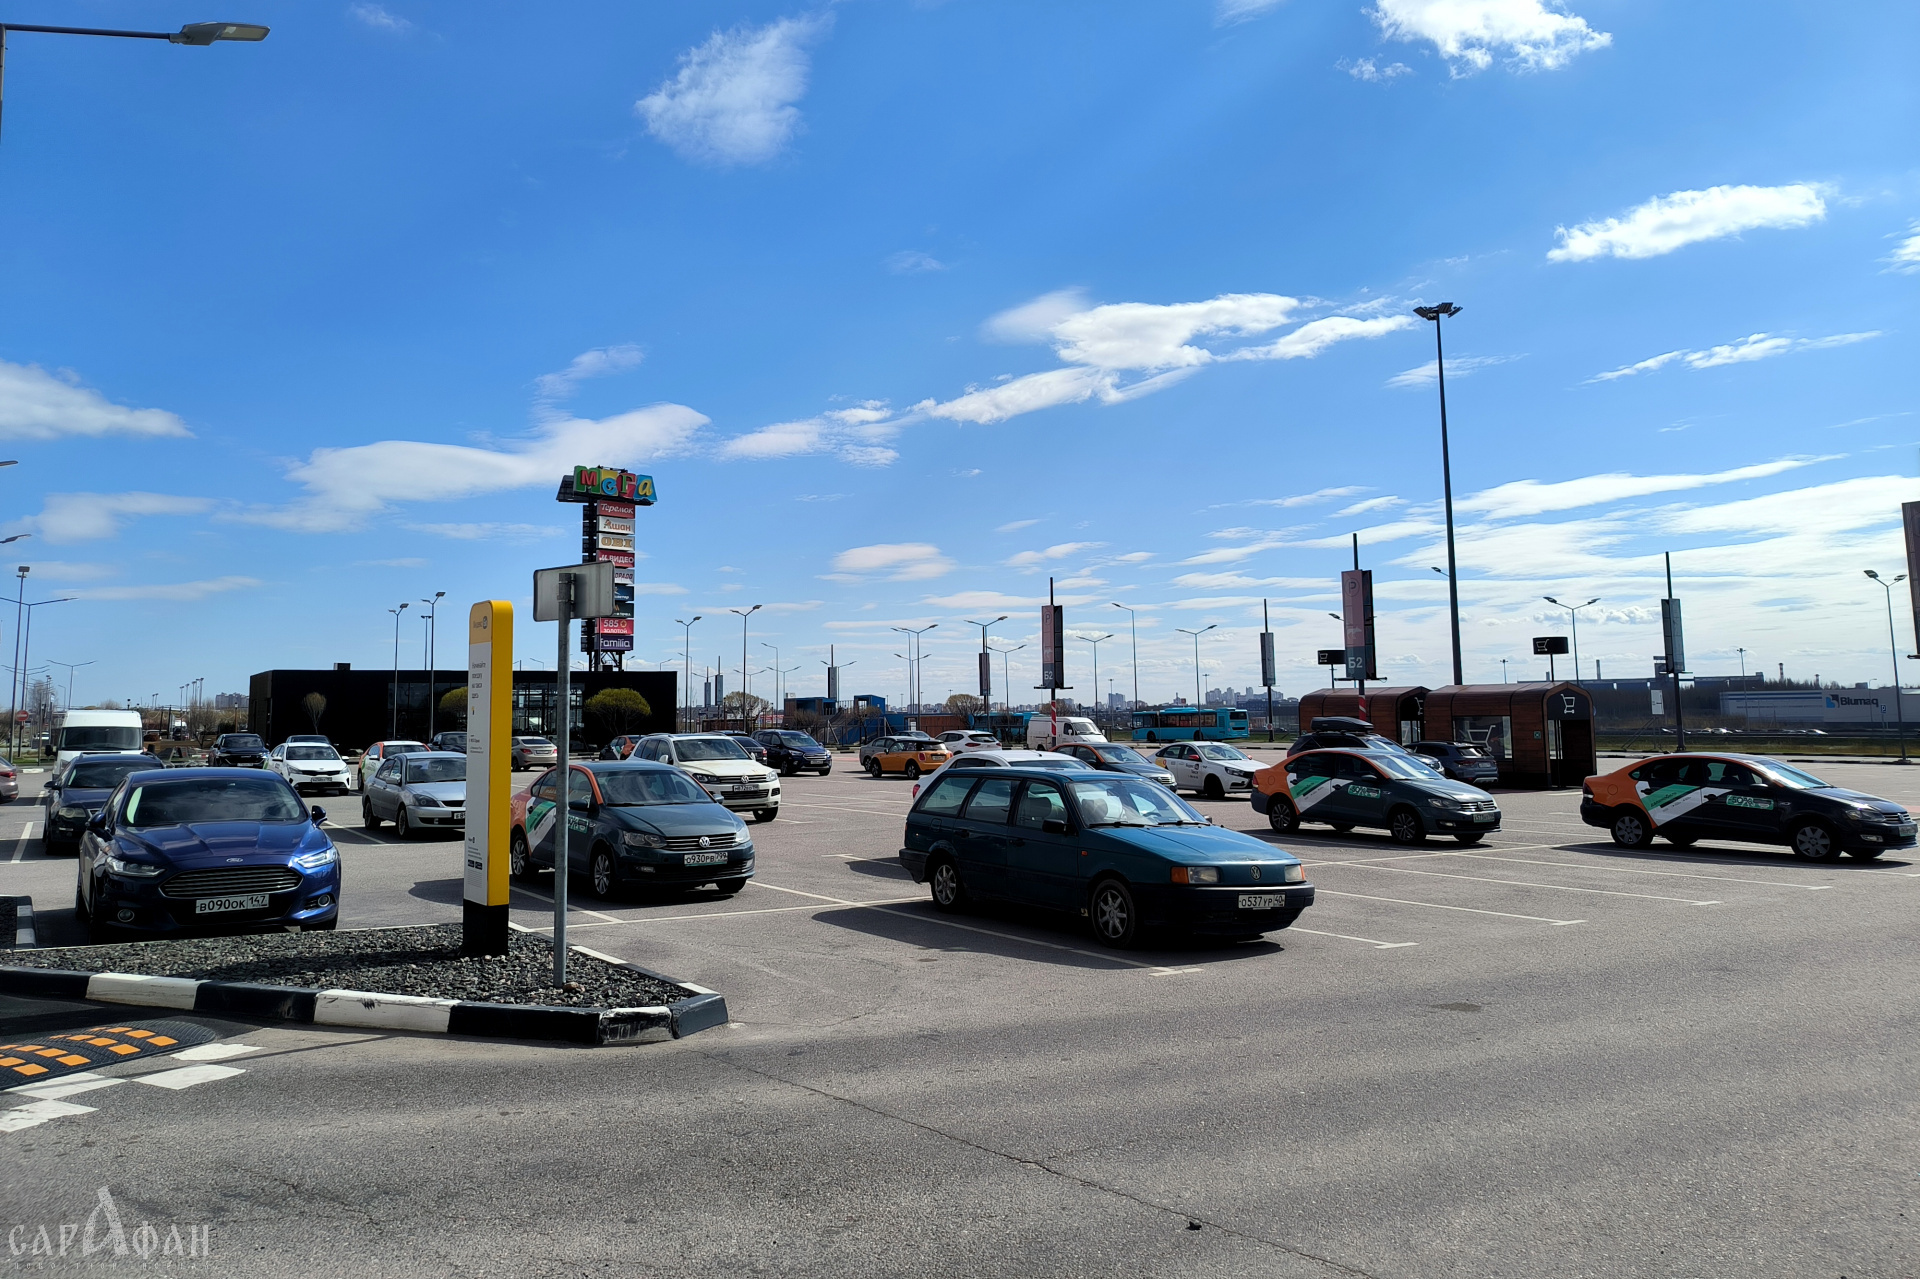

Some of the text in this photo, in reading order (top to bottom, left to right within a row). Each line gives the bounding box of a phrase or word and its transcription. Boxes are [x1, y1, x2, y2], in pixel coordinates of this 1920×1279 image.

[603, 518, 631, 531] Ашан
[601, 537, 632, 547] OBI
[603, 620, 619, 628] 585
[1348, 657, 1363, 668] Б2
[1044, 671, 1054, 680] Б2
[1840, 697, 1879, 708] Blumaq
